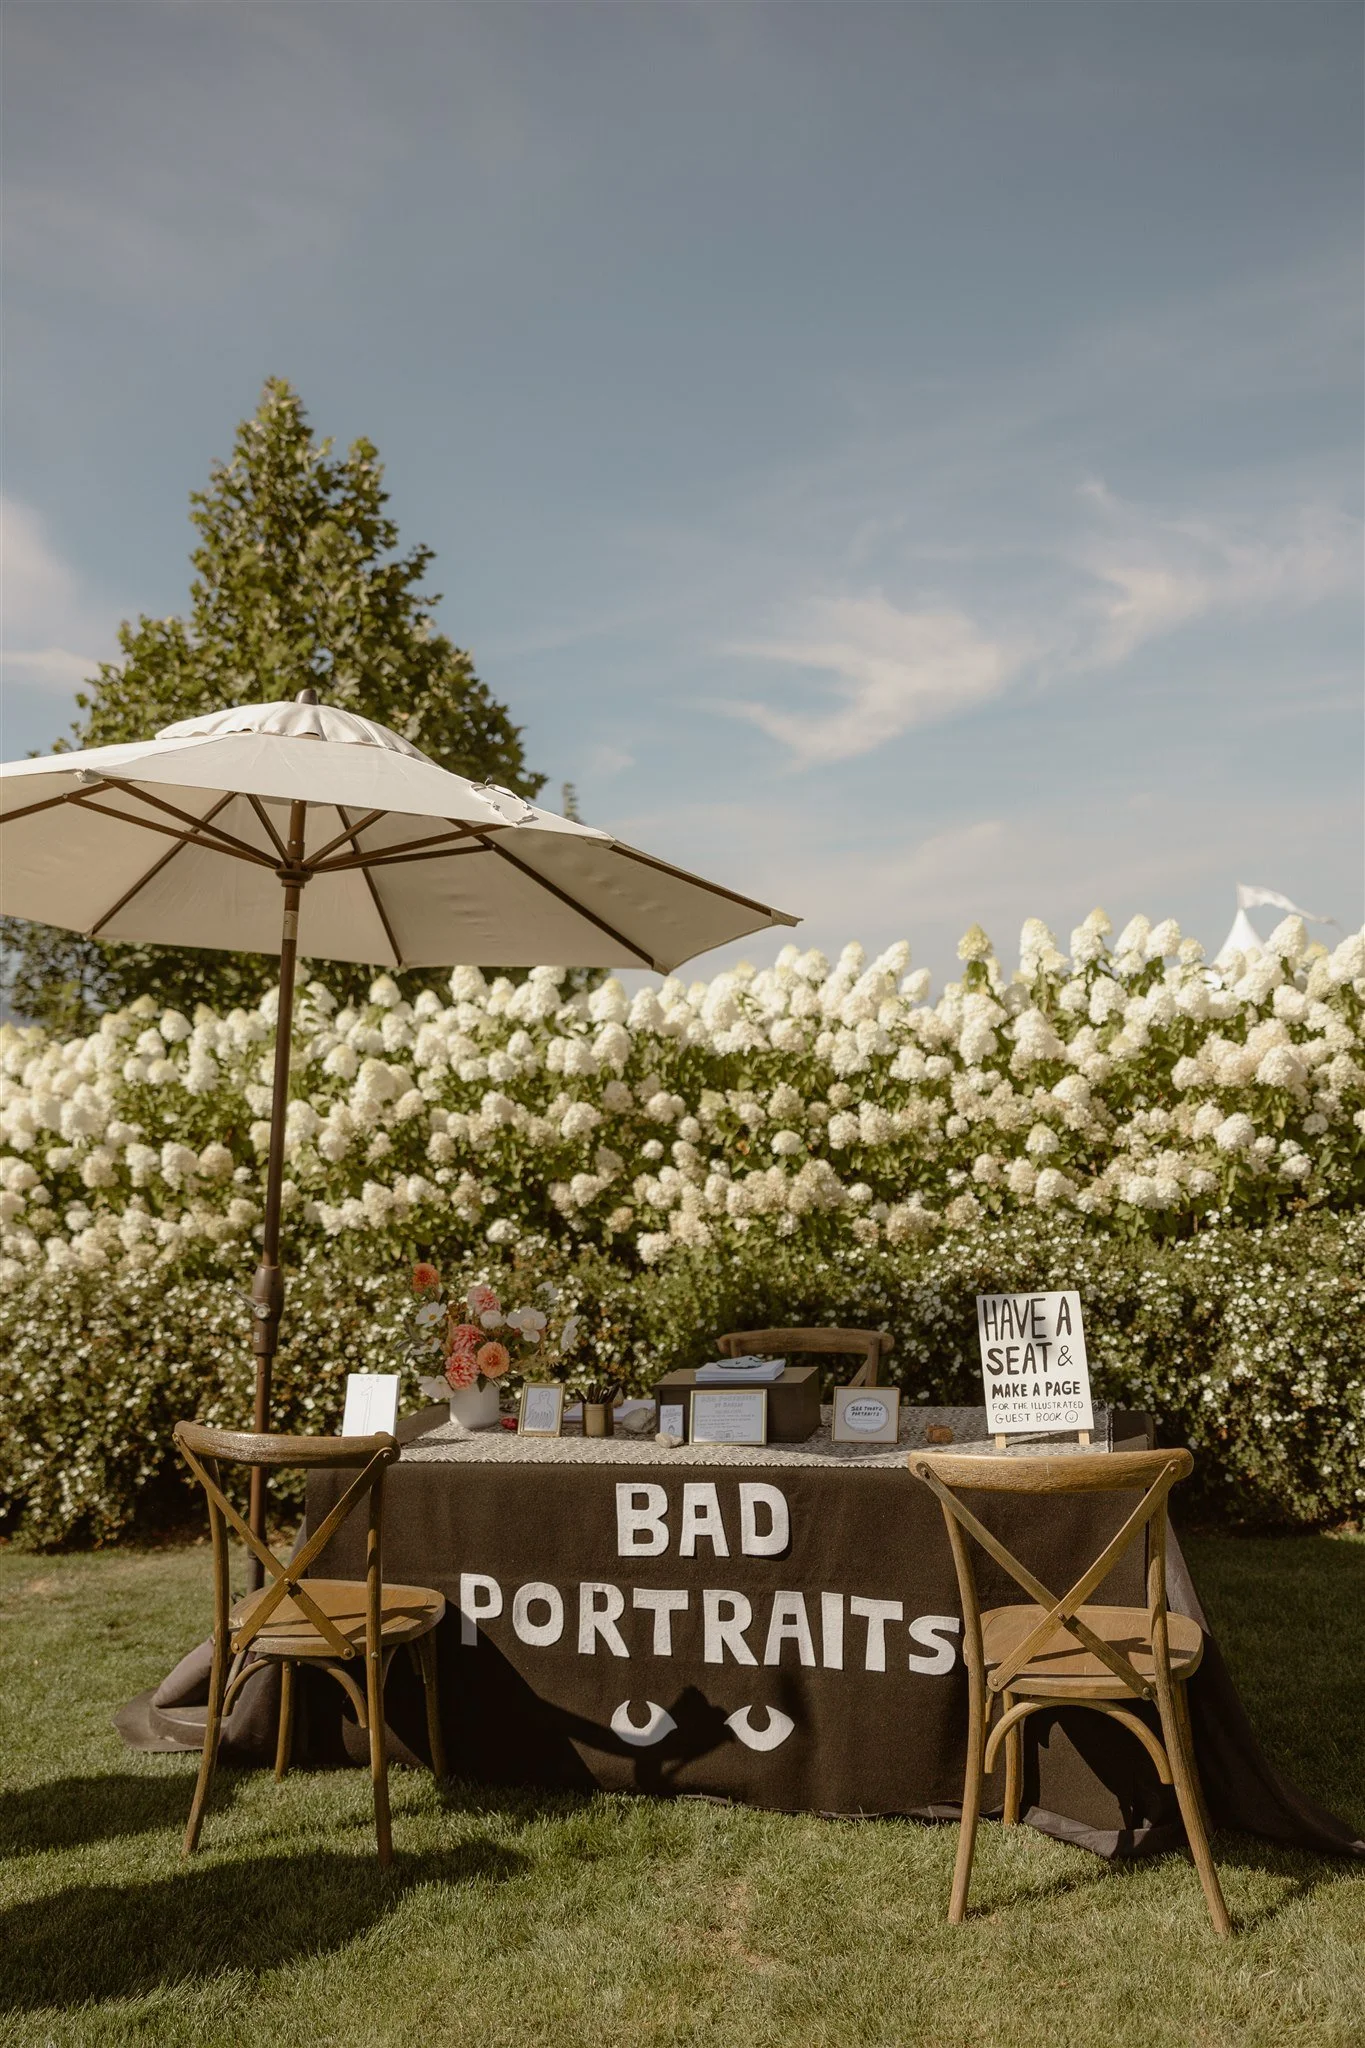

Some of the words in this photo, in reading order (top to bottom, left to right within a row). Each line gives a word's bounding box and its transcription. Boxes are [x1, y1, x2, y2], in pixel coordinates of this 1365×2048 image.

[983, 1298, 1047, 1341] HAVE
[1056, 1296, 1072, 1337] A
[986, 1341, 1053, 1376] SEAT
[1057, 1345, 1074, 1367] &
[992, 1383, 1028, 1399] MAKE
[1033, 1382, 1041, 1397] A
[1045, 1381, 1081, 1397] PAGE
[992, 1402, 1010, 1411] FOR
[1013, 1402, 1028, 1410] THE
[1031, 1401, 1084, 1410] ILLUSTRATED
[995, 1413, 1031, 1424] GUEST
[1036, 1412, 1063, 1422] BOOK
[615, 1482, 790, 1557] BAD
[459, 1572, 961, 1676] PORTRAITS
